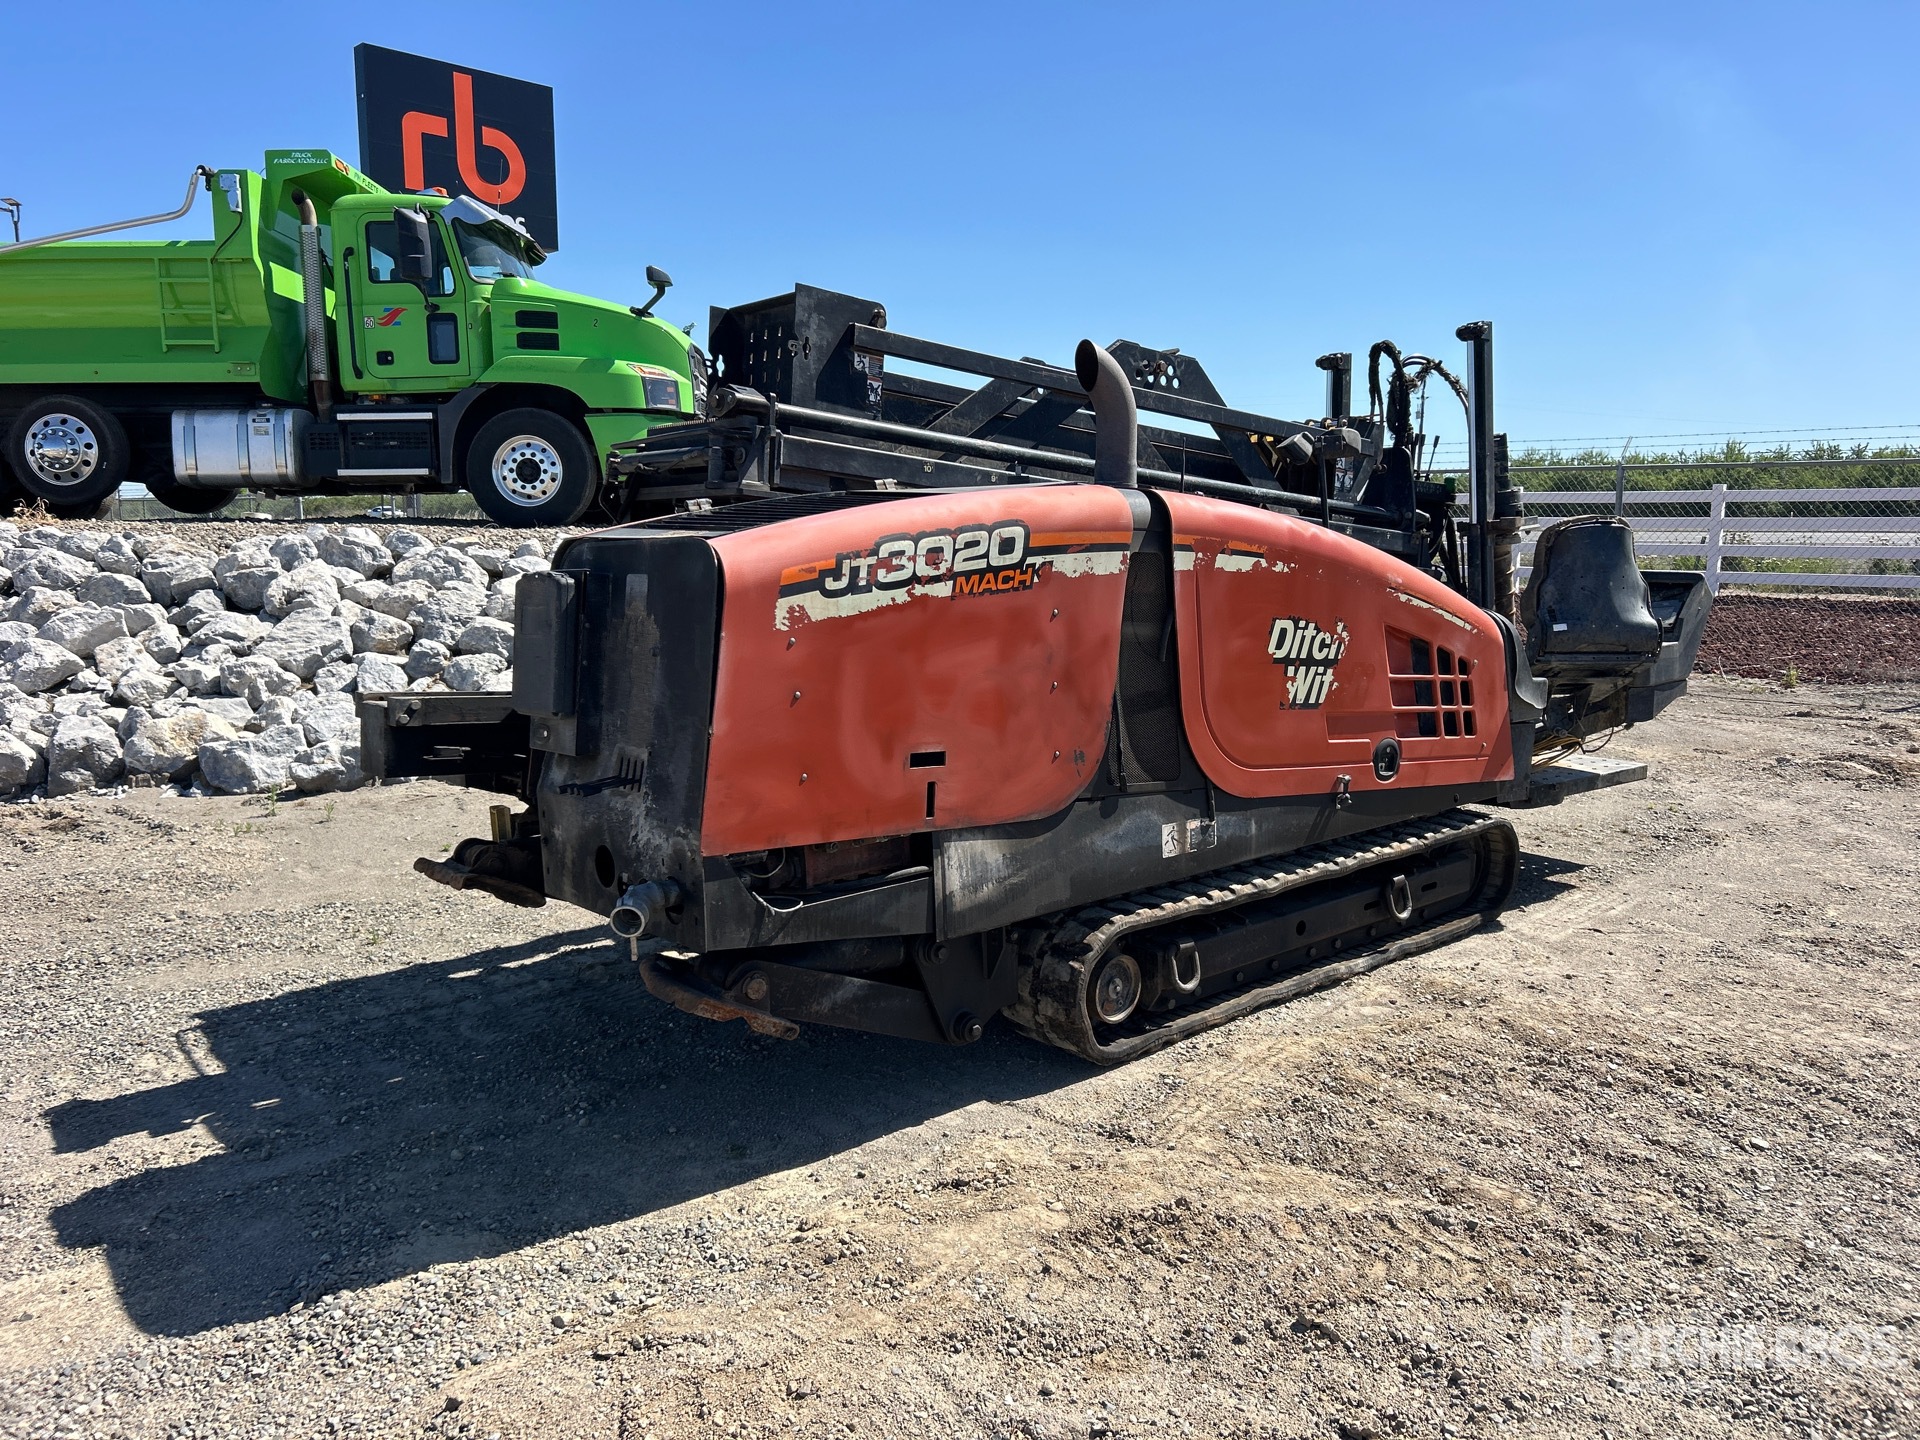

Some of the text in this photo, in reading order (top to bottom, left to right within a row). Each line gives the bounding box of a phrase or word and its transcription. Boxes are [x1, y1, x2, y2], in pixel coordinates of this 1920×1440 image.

[402, 71, 527, 205] rb
[365, 319, 374, 328] 60
[593, 318, 599, 328] 2
[825, 526, 1025, 591] JT3020
[955, 567, 1033, 595] MACH
